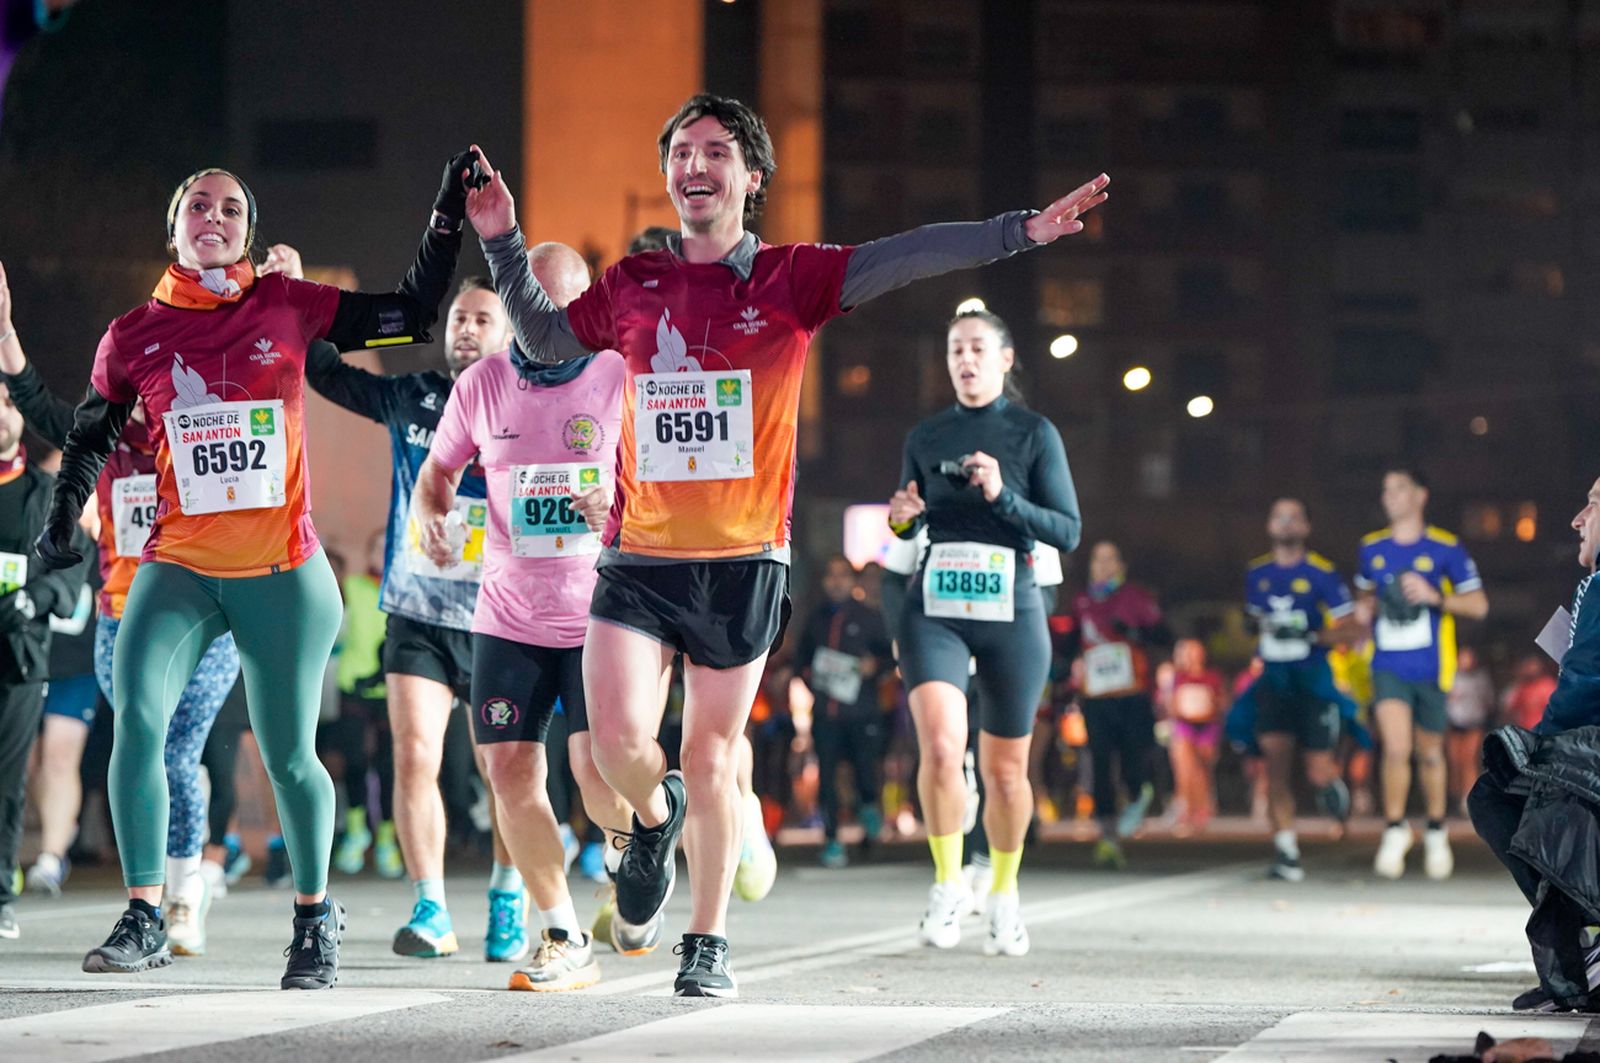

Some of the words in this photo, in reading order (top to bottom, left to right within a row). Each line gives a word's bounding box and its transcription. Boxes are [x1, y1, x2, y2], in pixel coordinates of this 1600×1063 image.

[658, 385, 689, 396] NOCHE
[692, 384, 705, 394] DE
[647, 398, 668, 411] SAN
[668, 395, 706, 409] ANTÓN
[193, 415, 224, 428] NOCHE
[227, 414, 239, 424] DE
[655, 411, 728, 444] 6591
[182, 430, 203, 444] SAN
[205, 425, 241, 441] ANTÓN
[678, 445, 705, 453] Manuel
[192, 439, 267, 476] 6592
[558, 473, 570, 484] DE
[537, 484, 571, 496] ANTÓN
[545, 526, 572, 534] MANUEL
[936, 571, 1001, 594] 13893
